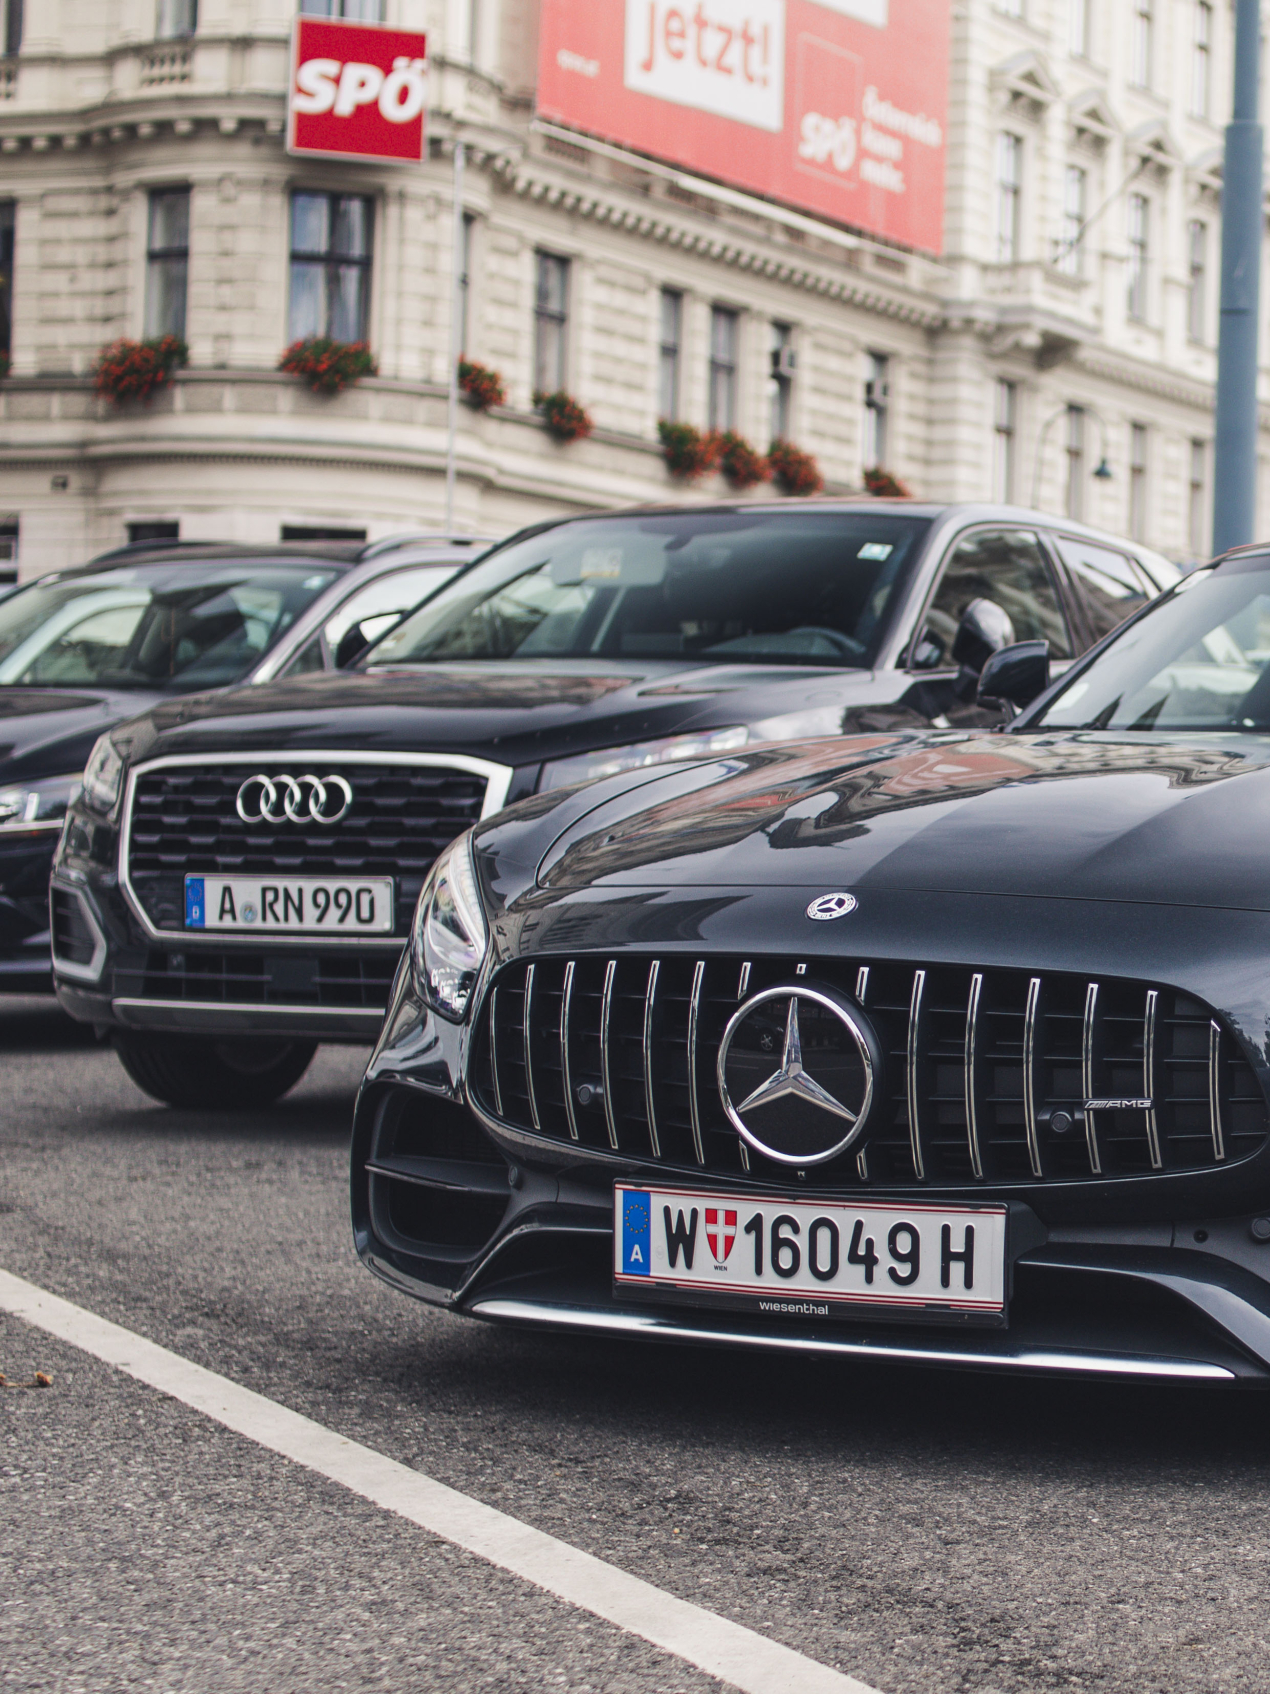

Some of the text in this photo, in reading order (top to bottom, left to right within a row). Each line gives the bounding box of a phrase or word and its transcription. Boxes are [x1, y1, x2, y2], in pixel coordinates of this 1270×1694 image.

[292, 56, 427, 124] SPÖ
[798, 112, 857, 172] SPÖ
[218, 885, 237, 922] A
[630, 1244, 644, 1263] A
[663, 1204, 975, 1290] W 16049 H
[713, 1264, 728, 1272] WIEN
[759, 1301, 829, 1316] wiesenthal
